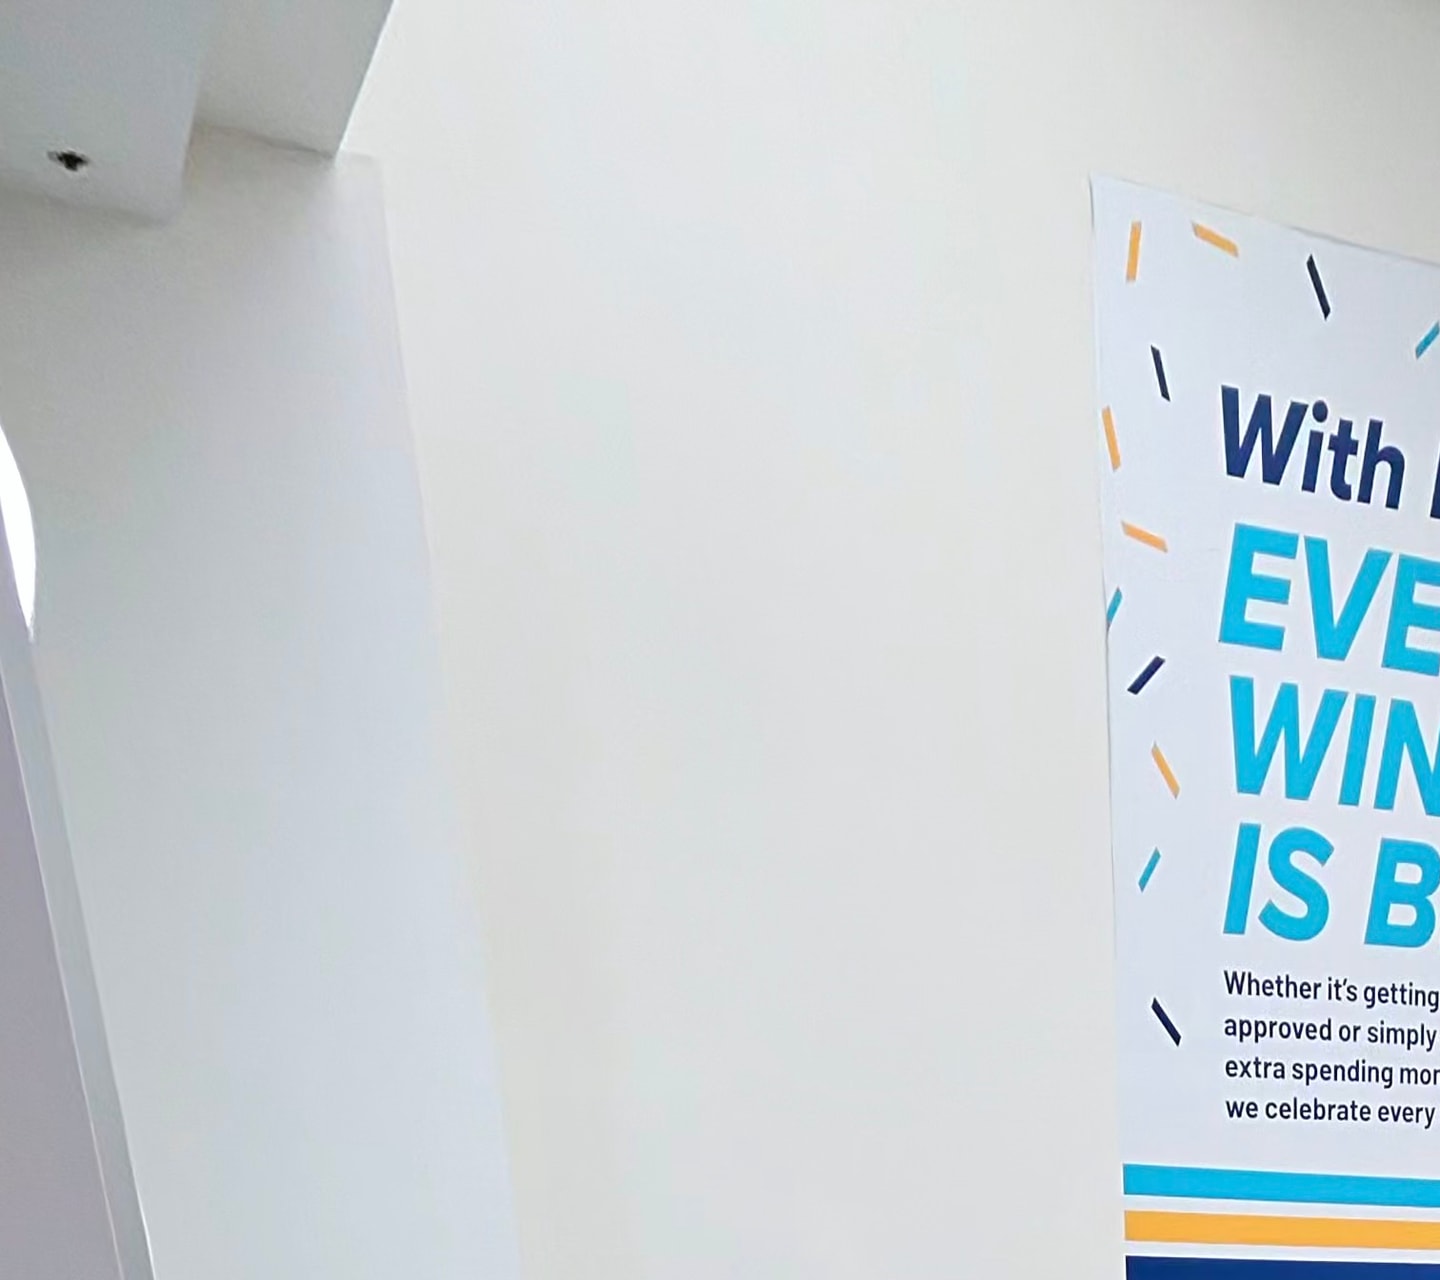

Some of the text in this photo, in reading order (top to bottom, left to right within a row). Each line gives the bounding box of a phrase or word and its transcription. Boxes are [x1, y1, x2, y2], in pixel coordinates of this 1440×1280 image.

[1221, 384, 1405, 509] With
[1224, 823, 1334, 941] IS
[1224, 970, 1322, 1000] Whether
[1364, 982, 1439, 1013] getting
[1224, 1017, 1332, 1043] approved
[1338, 1023, 1361, 1042] or
[1367, 1021, 1437, 1052] simply
[1225, 1057, 1286, 1080] extra
[1292, 1059, 1393, 1089] spending
[1226, 1100, 1258, 1120] we
[1265, 1096, 1371, 1122] celebrate
[1377, 1105, 1435, 1130] every
